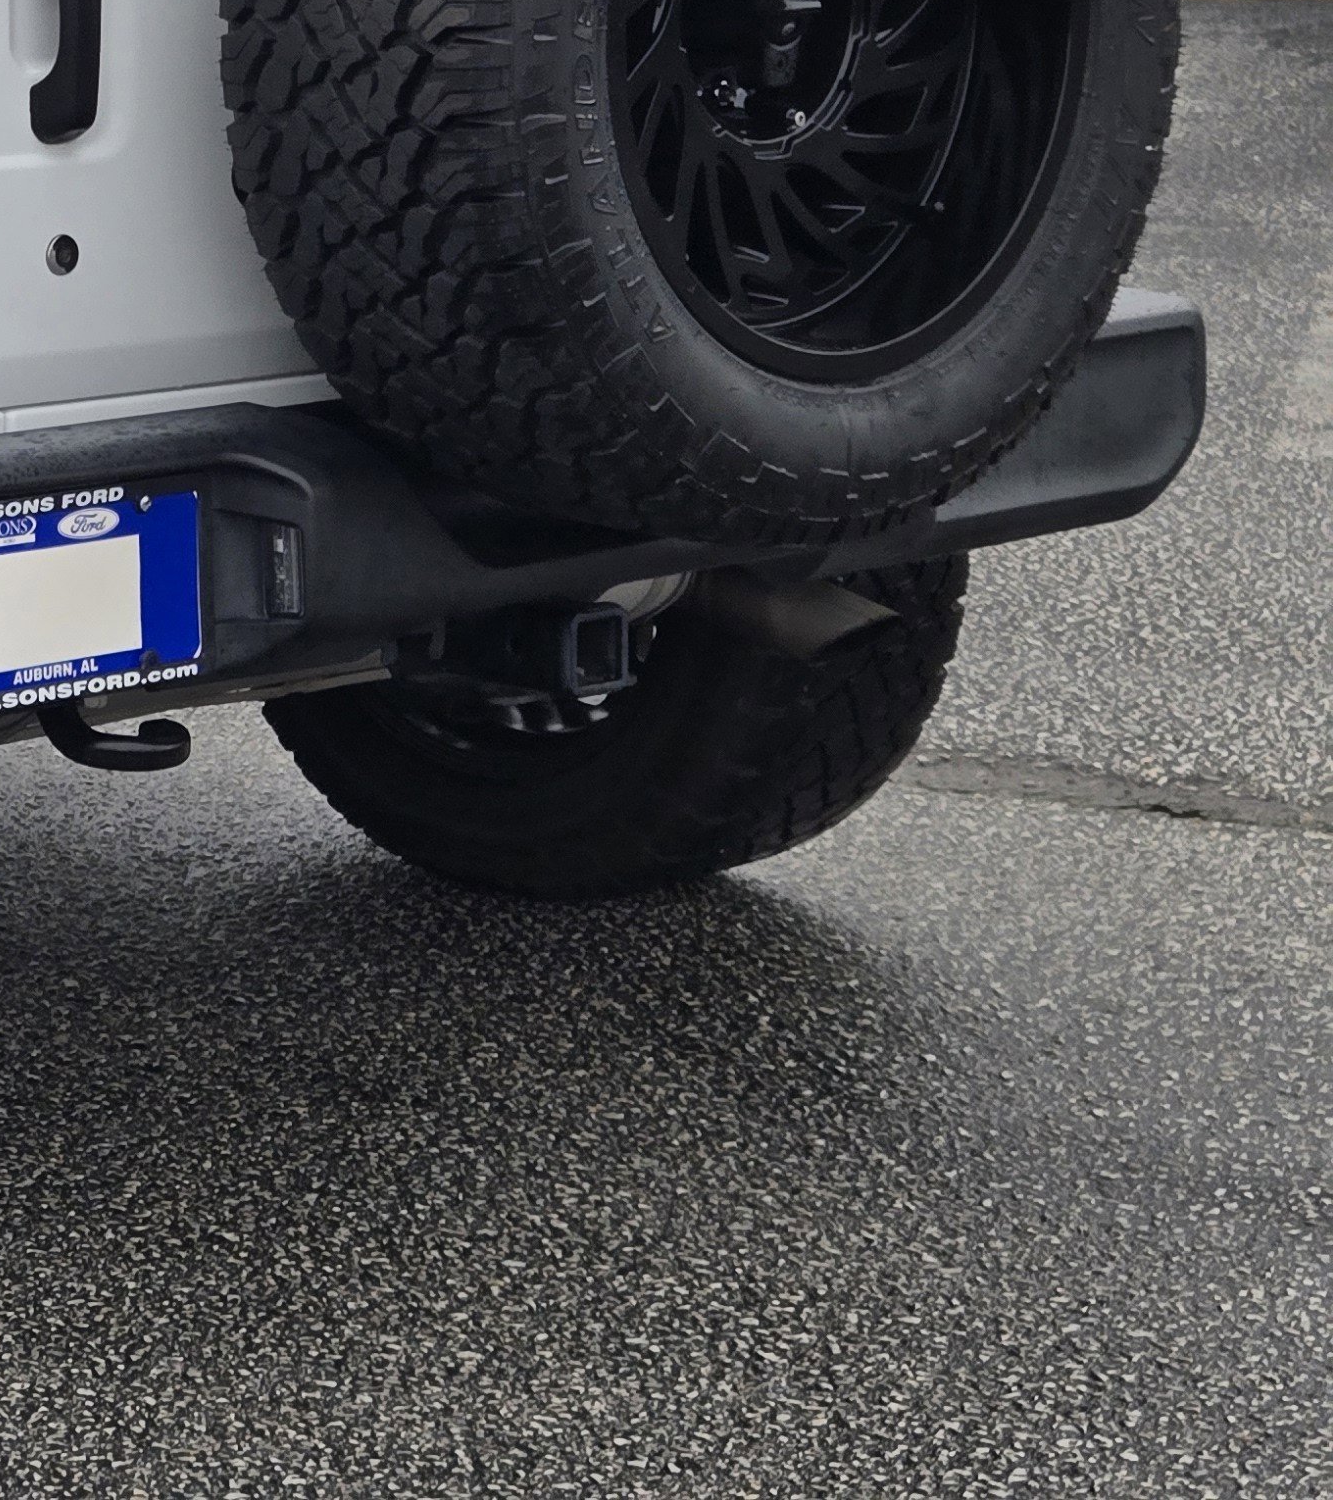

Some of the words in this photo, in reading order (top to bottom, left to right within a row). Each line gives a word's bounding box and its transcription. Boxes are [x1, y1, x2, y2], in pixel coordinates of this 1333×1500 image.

[61, 486, 124, 509] FORD
[70, 513, 108, 534] Ford
[12, 661, 77, 686] AUBURN,
[80, 657, 99, 673] AL
